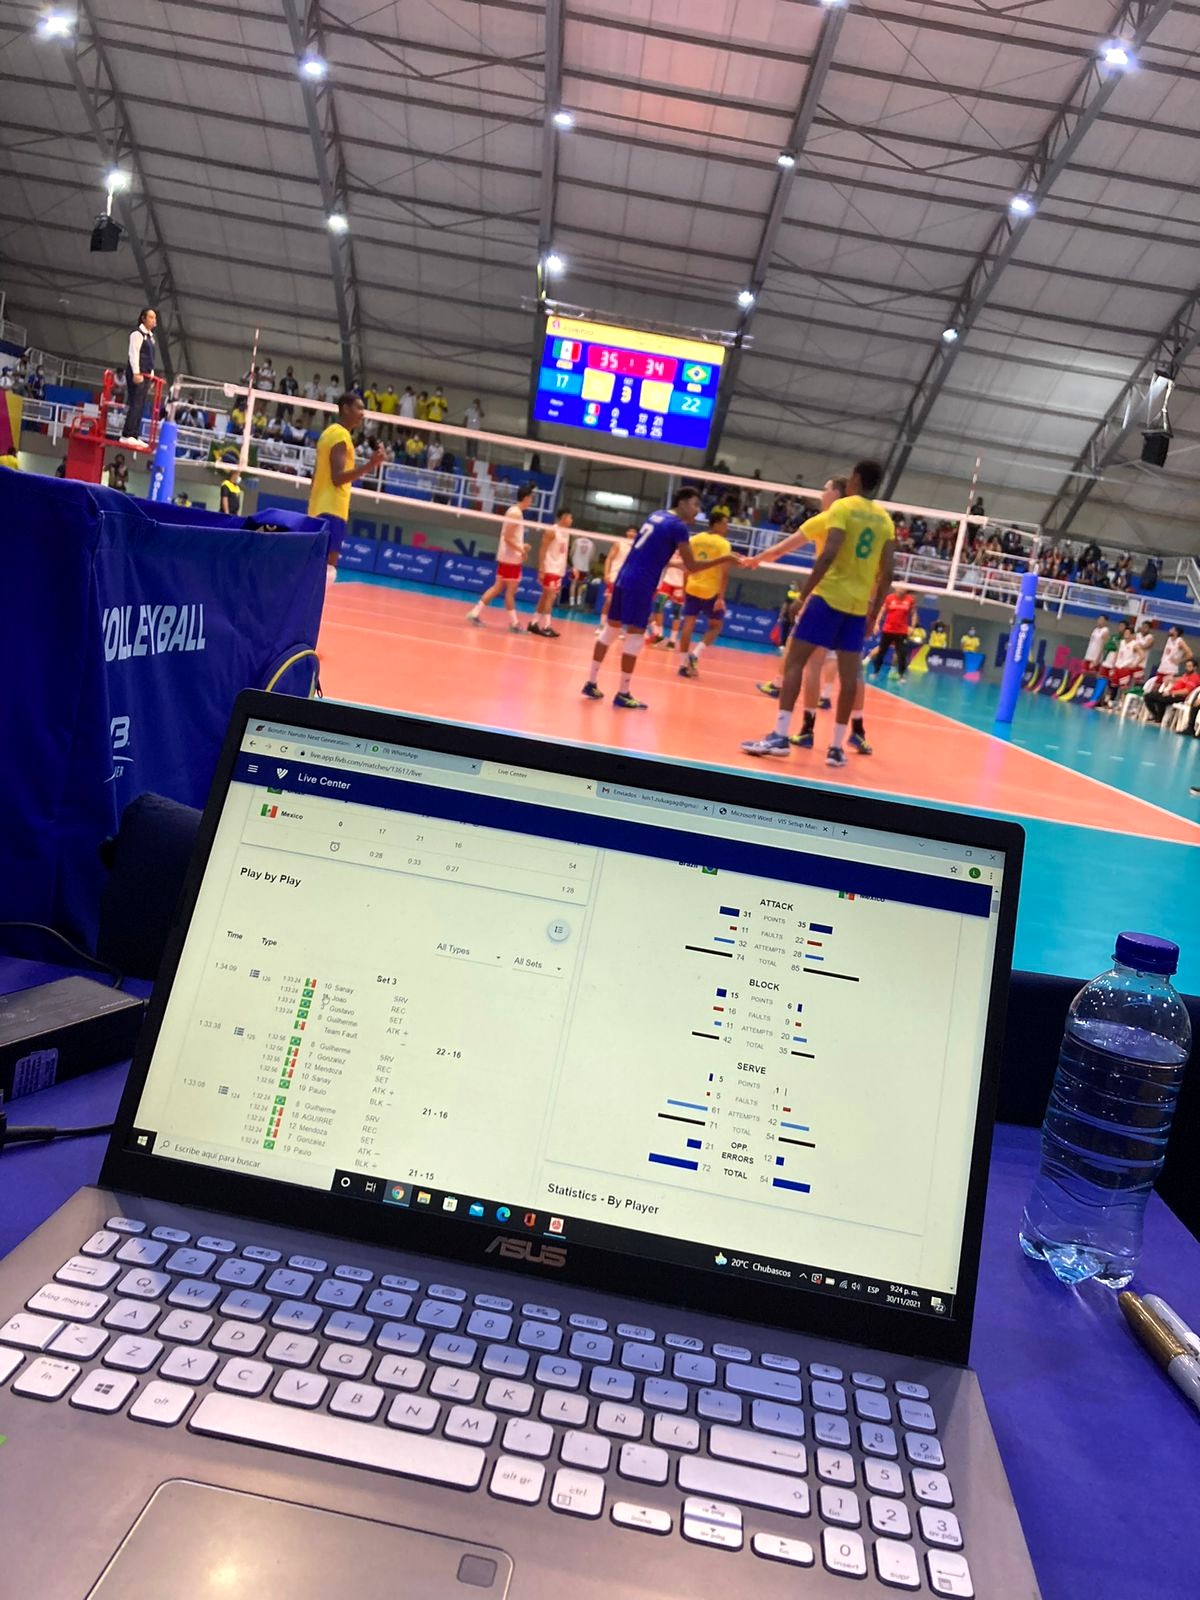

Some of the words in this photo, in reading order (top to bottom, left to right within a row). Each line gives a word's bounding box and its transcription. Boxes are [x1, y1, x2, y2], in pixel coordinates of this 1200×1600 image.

[600, 352, 618, 368] 35
[645, 358, 664, 376] 34
[556, 374, 569, 388] 17
[681, 397, 701, 412] 22
[635, 523, 654, 549] 7
[856, 527, 875, 559] 8
[103, 604, 205, 661] OLLEYBALL
[510, 770, 528, 779] Center
[298, 773, 317, 784] Live
[320, 777, 351, 790] Center
[281, 810, 303, 820] Mexico
[240, 866, 261, 882] Play
[264, 873, 277, 885] by
[280, 874, 302, 888] Play
[760, 898, 794, 911] ATTACK
[763, 916, 786, 925] POINTS
[227, 931, 243, 940] Time
[262, 937, 277, 946] Type
[761, 930, 783, 940] FAULTS
[436, 942, 447, 952] All
[448, 944, 470, 956] Types
[754, 944, 786, 955] ATTEMPTS
[513, 956, 524, 966] All
[525, 958, 543, 970] Sets
[759, 958, 777, 967] TOTAL
[377, 975, 390, 984] Set
[749, 979, 780, 991] BLOCK
[751, 996, 773, 1005] POINTS
[748, 1012, 771, 1021] FAULTS
[324, 1027, 341, 1036] Team
[342, 1030, 358, 1039] Fault
[741, 1026, 773, 1037] ATTEMPTS
[746, 1041, 764, 1050] TOTAL
[380, 1054, 394, 1063] SRV
[436, 1047, 446, 1056] 22
[452, 1051, 462, 1059] 16
[314, 1063, 343, 1076] Mendoza
[377, 1064, 392, 1074] REC
[737, 1062, 766, 1074] SERVE
[738, 1080, 761, 1089] POINTS
[372, 1087, 386, 1095] ATK
[370, 1098, 383, 1107] BLK
[736, 1096, 758, 1106] FAULTS
[422, 1107, 432, 1117] 21
[439, 1110, 448, 1120] 16
[728, 1111, 760, 1122] ATTEMPTS
[302, 1113, 333, 1126] AGUIRRE
[732, 1127, 751, 1136] TOTAL
[174, 1144, 200, 1156] Escribe
[201, 1150, 218, 1162] aquí
[218, 1153, 236, 1164] para
[236, 1156, 261, 1168] buscar
[722, 1152, 754, 1164] ERRORS
[408, 1168, 418, 1178] 21
[425, 1172, 434, 1181] 15
[724, 1168, 748, 1180] TOTAL
[547, 1183, 597, 1202] Statistics
[607, 1195, 622, 1209] By
[625, 1198, 660, 1215] Player
[485, 1236, 567, 1268] ASUS
[186, 1257, 197, 1265] 2
[752, 1262, 791, 1278] Chubascos
[136, 1278, 151, 1288] Q
[867, 1285, 880, 1294] ESP
[886, 1295, 921, 1308] 30/11/2021
[124, 1310, 138, 1320] A
[291, 1310, 303, 1319] R
[179, 1320, 192, 1330] S
[484, 1320, 495, 1329] 8
[232, 1331, 246, 1340] D
[126, 1347, 141, 1357] Z
[447, 1343, 461, 1353] U
[181, 1358, 197, 1368] X
[339, 1354, 353, 1364] G
[392, 1366, 407, 1376] H
[607, 1377, 617, 1387] P
[351, 1393, 362, 1404] B
[503, 1390, 515, 1400] K
[406, 1406, 422, 1416] N
[615, 1413, 626, 1424] Ñ
[462, 1419, 479, 1430] M
[831, 1460, 842, 1470] 4
[886, 1510, 896, 1521] 2
